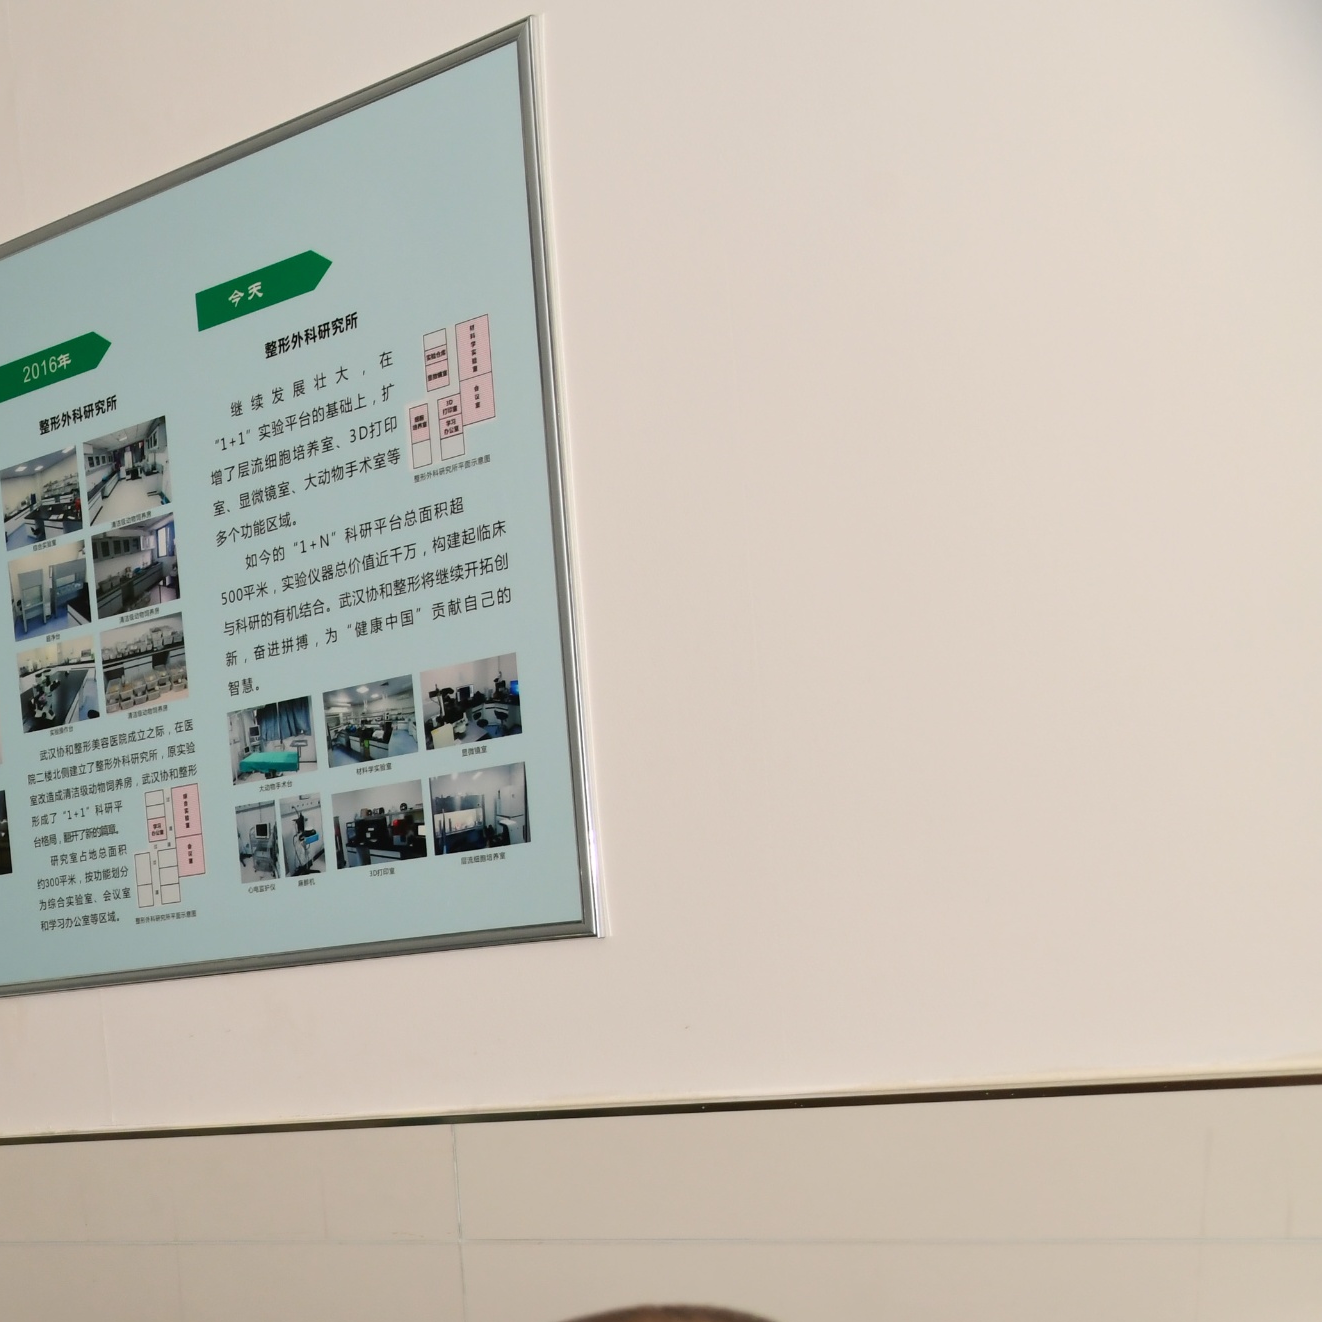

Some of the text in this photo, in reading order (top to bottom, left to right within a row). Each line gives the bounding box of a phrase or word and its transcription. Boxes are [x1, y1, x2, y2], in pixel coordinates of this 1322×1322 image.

[228, 282, 264, 307] 今天
[264, 312, 358, 359] 整形外科研究所
[22, 349, 72, 384] 2016年
[38, 394, 118, 435] 整形外科研究所
[215, 508, 298, 547] 多个功能区域。
[50, 843, 127, 866] 研究室占地总面积
